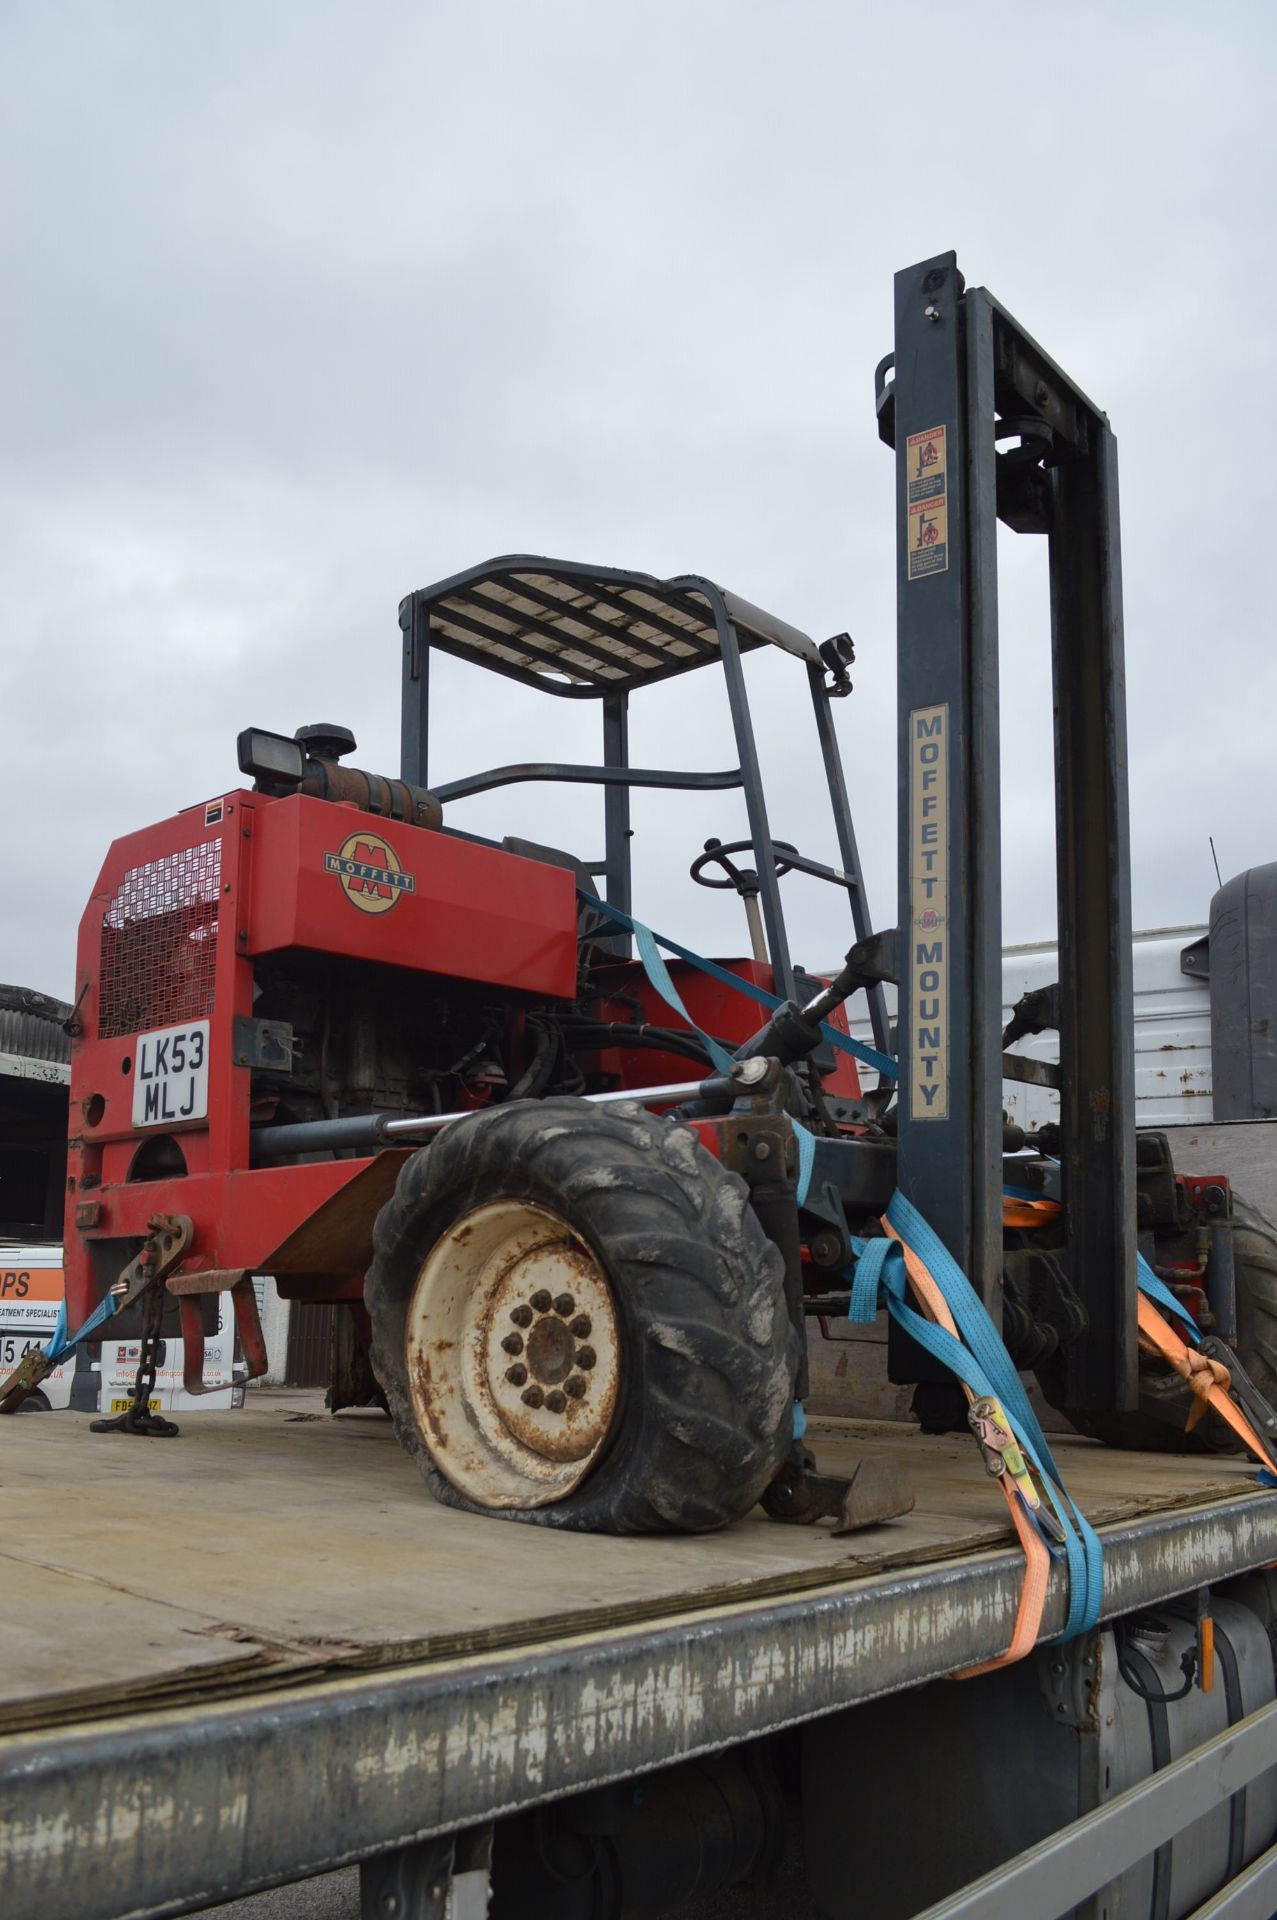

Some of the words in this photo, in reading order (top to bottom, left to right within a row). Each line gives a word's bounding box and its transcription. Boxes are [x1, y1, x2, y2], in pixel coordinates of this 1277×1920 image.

[916, 715, 942, 898] MOFFETT
[330, 858, 410, 888] MOFFETT
[916, 942, 943, 1106] MOUNTY
[140, 1030, 204, 1080] LK53
[144, 1076, 195, 1122] MLJ
[0, 1272, 30, 1297] PS
